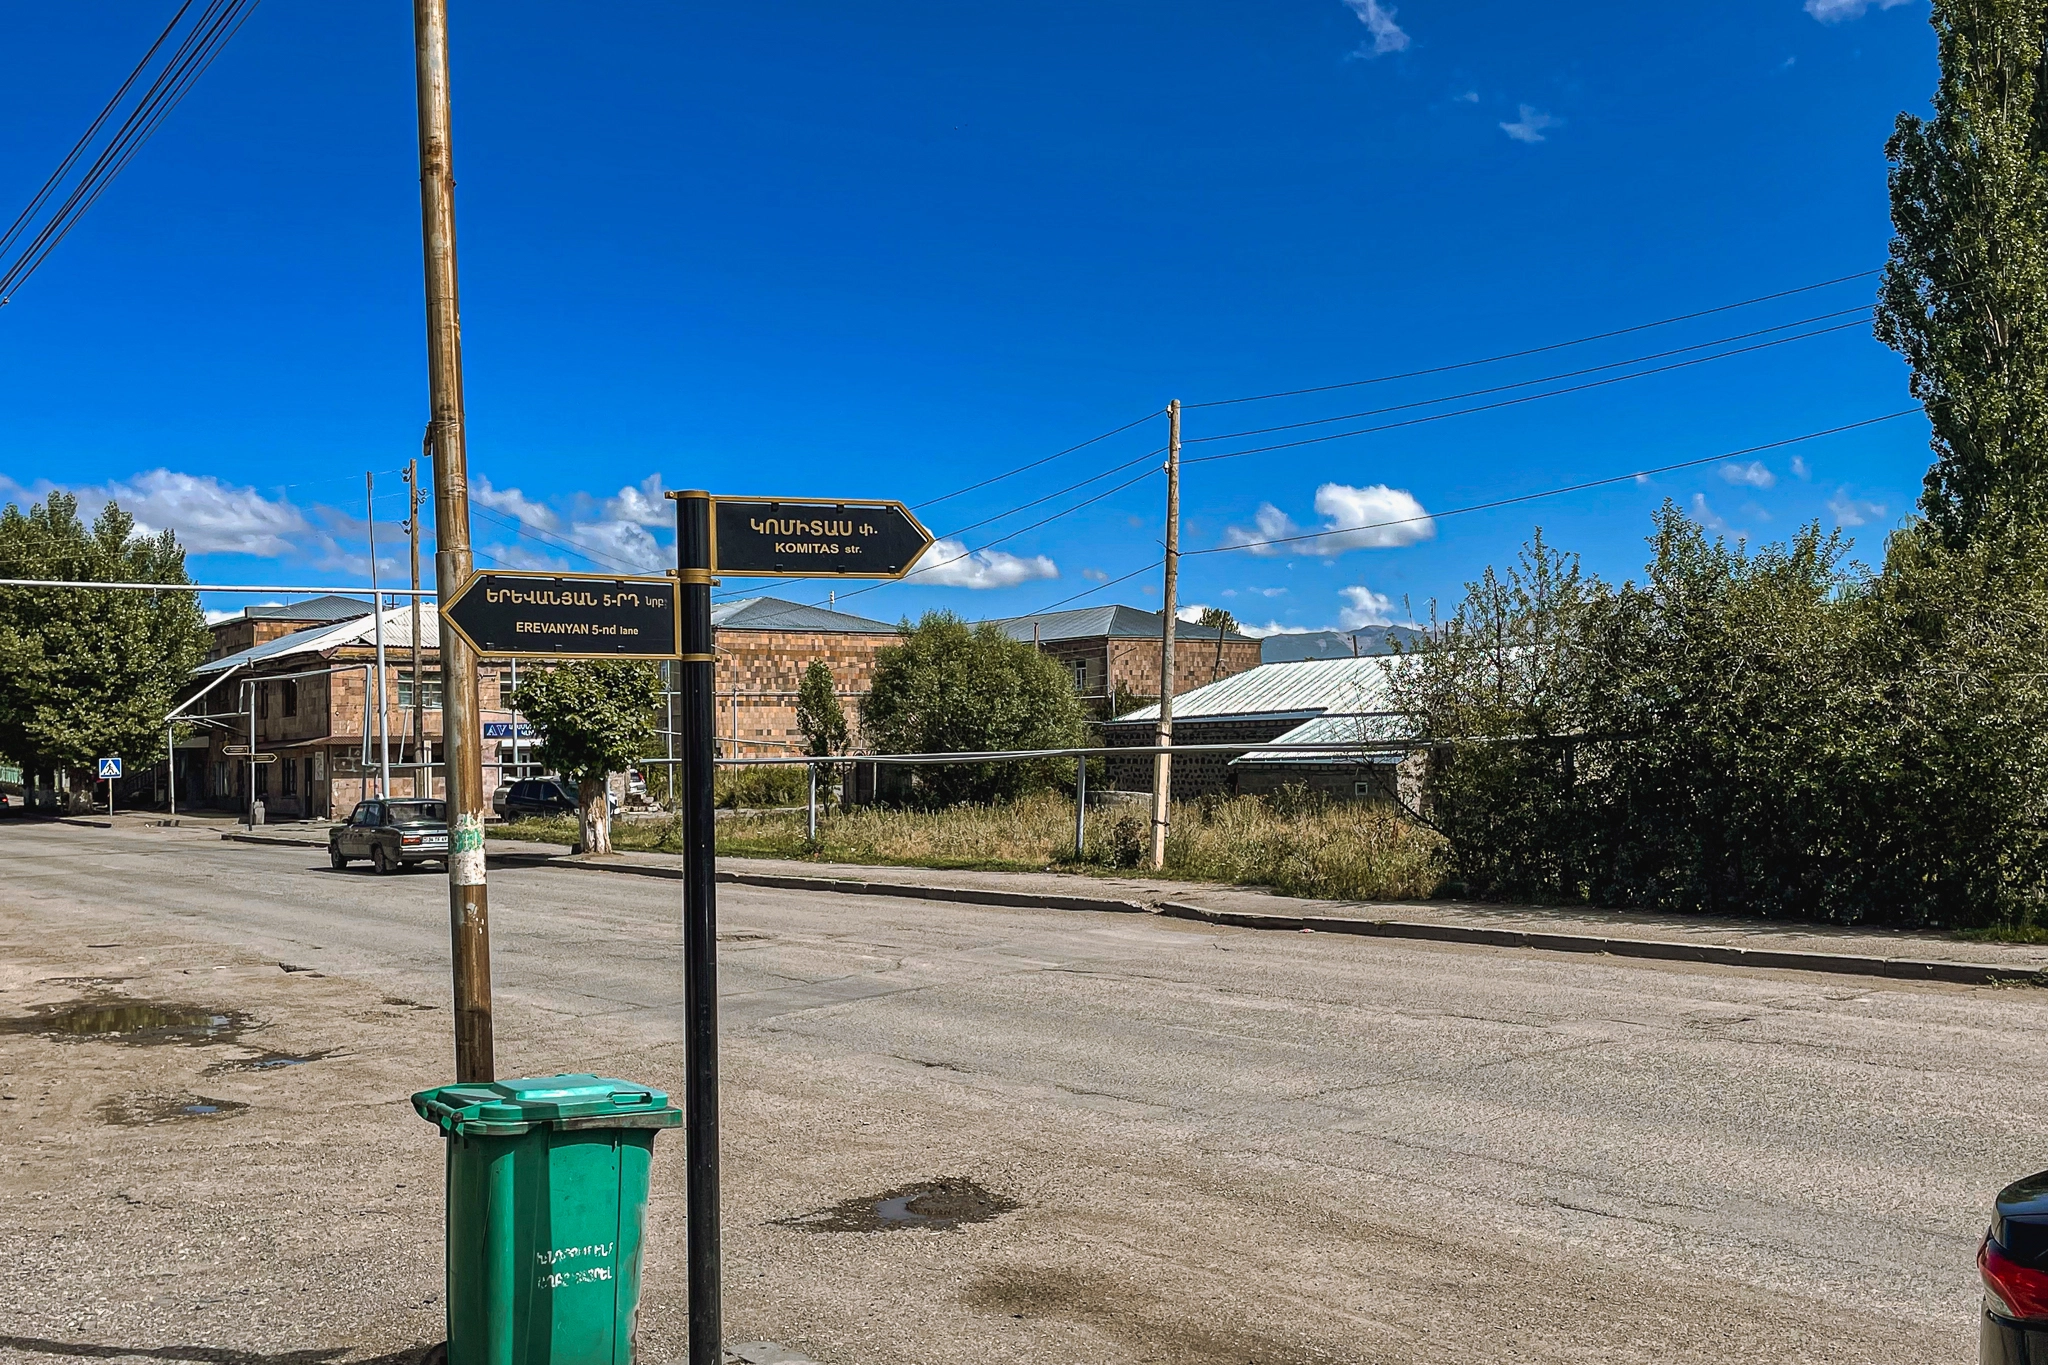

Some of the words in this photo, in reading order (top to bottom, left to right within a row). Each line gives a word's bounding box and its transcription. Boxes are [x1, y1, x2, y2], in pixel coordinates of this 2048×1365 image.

[750, 517, 853, 537] ԿՈՄԻՏԱՍ
[858, 522, 879, 537] փ.
[775, 542, 840, 554] KOMITAS
[844, 543, 863, 554] str.
[486, 588, 599, 607] ԵՐԵՎԱՆՅԱՆ
[602, 593, 640, 608] 5-ՐԴ
[515, 621, 589, 635] EREVANYAN
[591, 623, 617, 636] 5-nd
[619, 625, 640, 636] lane
